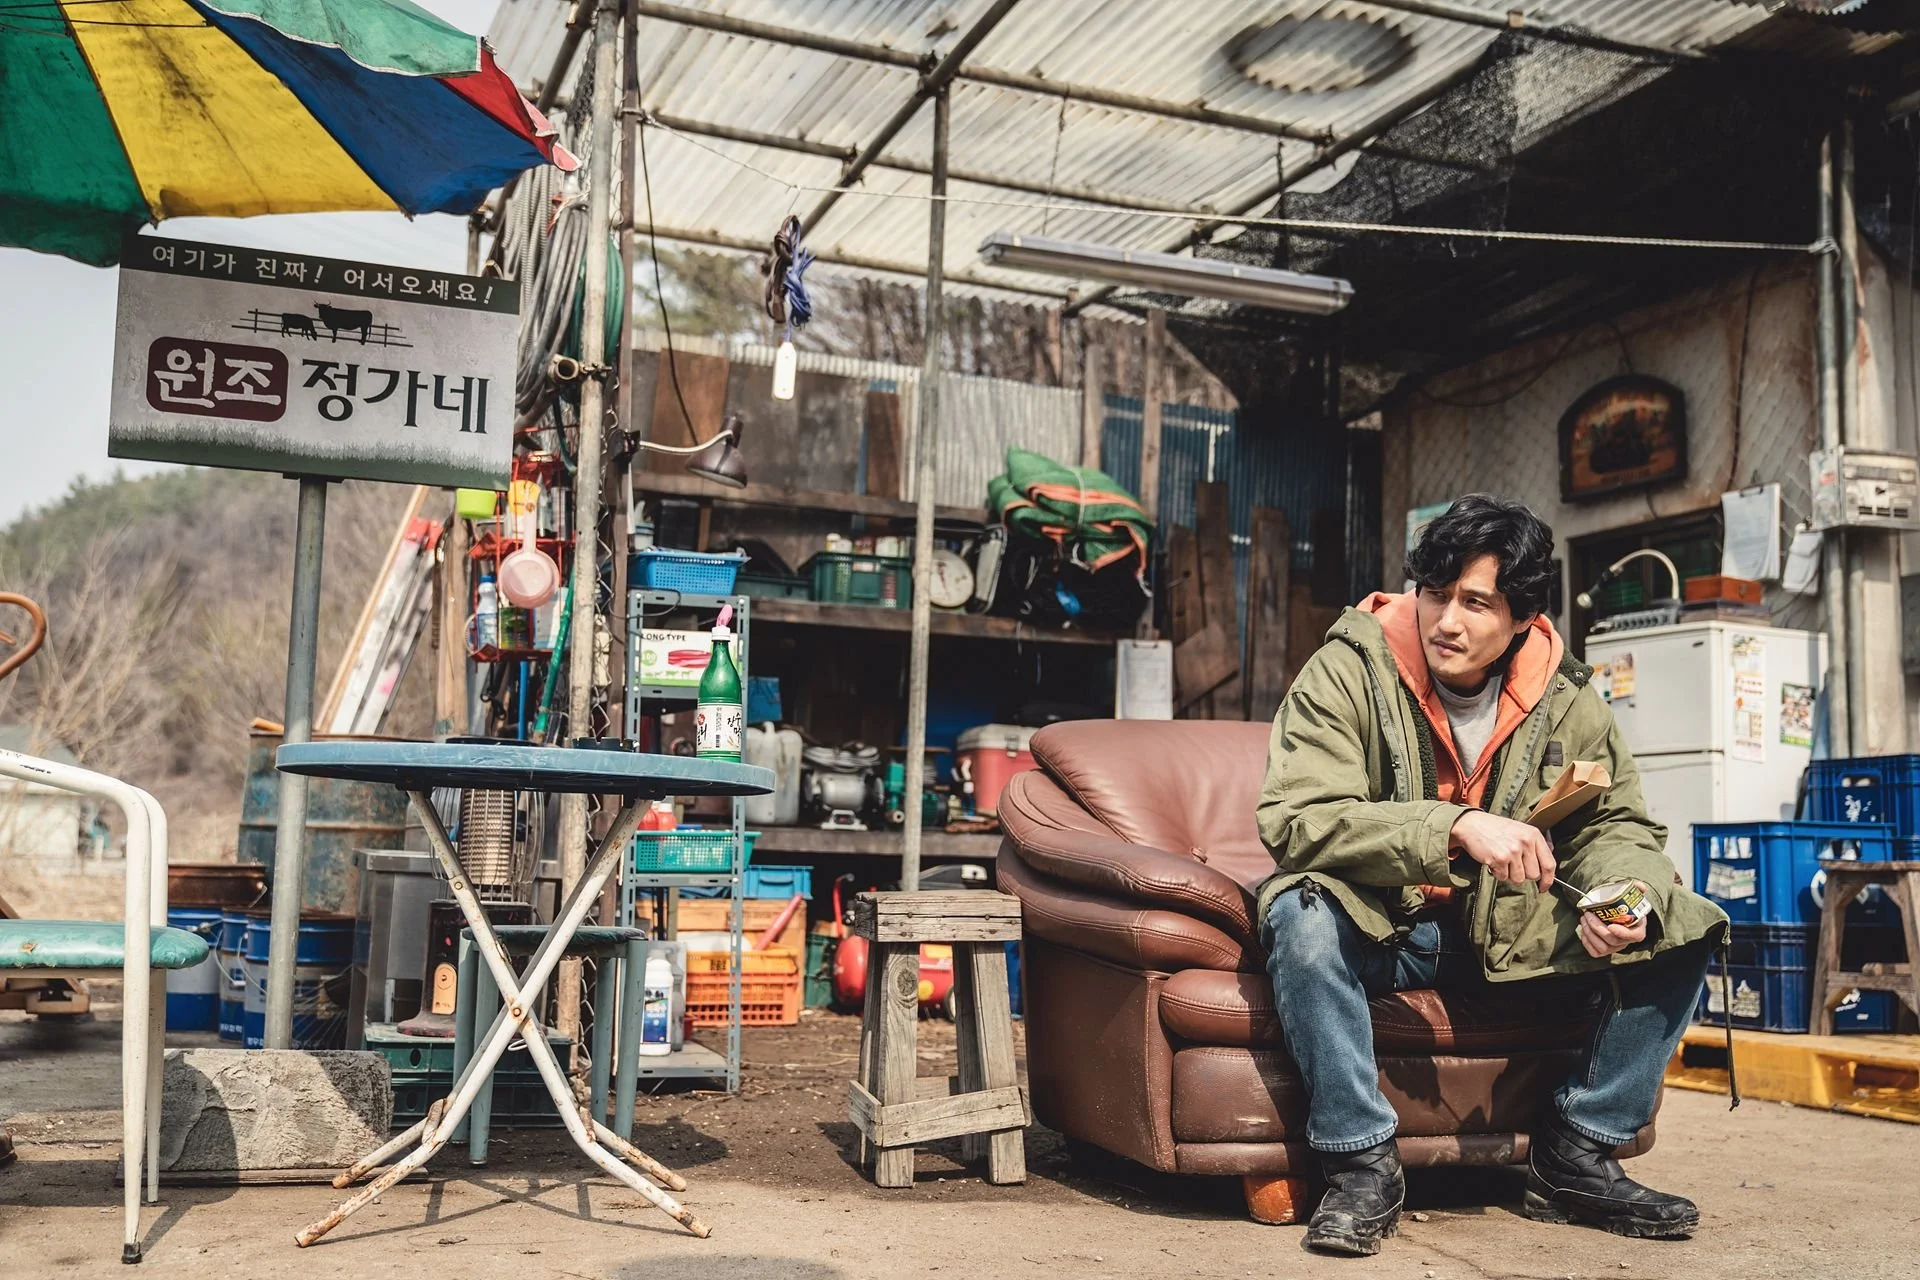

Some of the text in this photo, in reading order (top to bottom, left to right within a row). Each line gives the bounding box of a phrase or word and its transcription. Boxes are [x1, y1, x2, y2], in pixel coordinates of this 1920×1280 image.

[152, 246, 494, 305] 여기가 진짜! 어서오세요!
[153, 347, 490, 435] 원조 정가네
